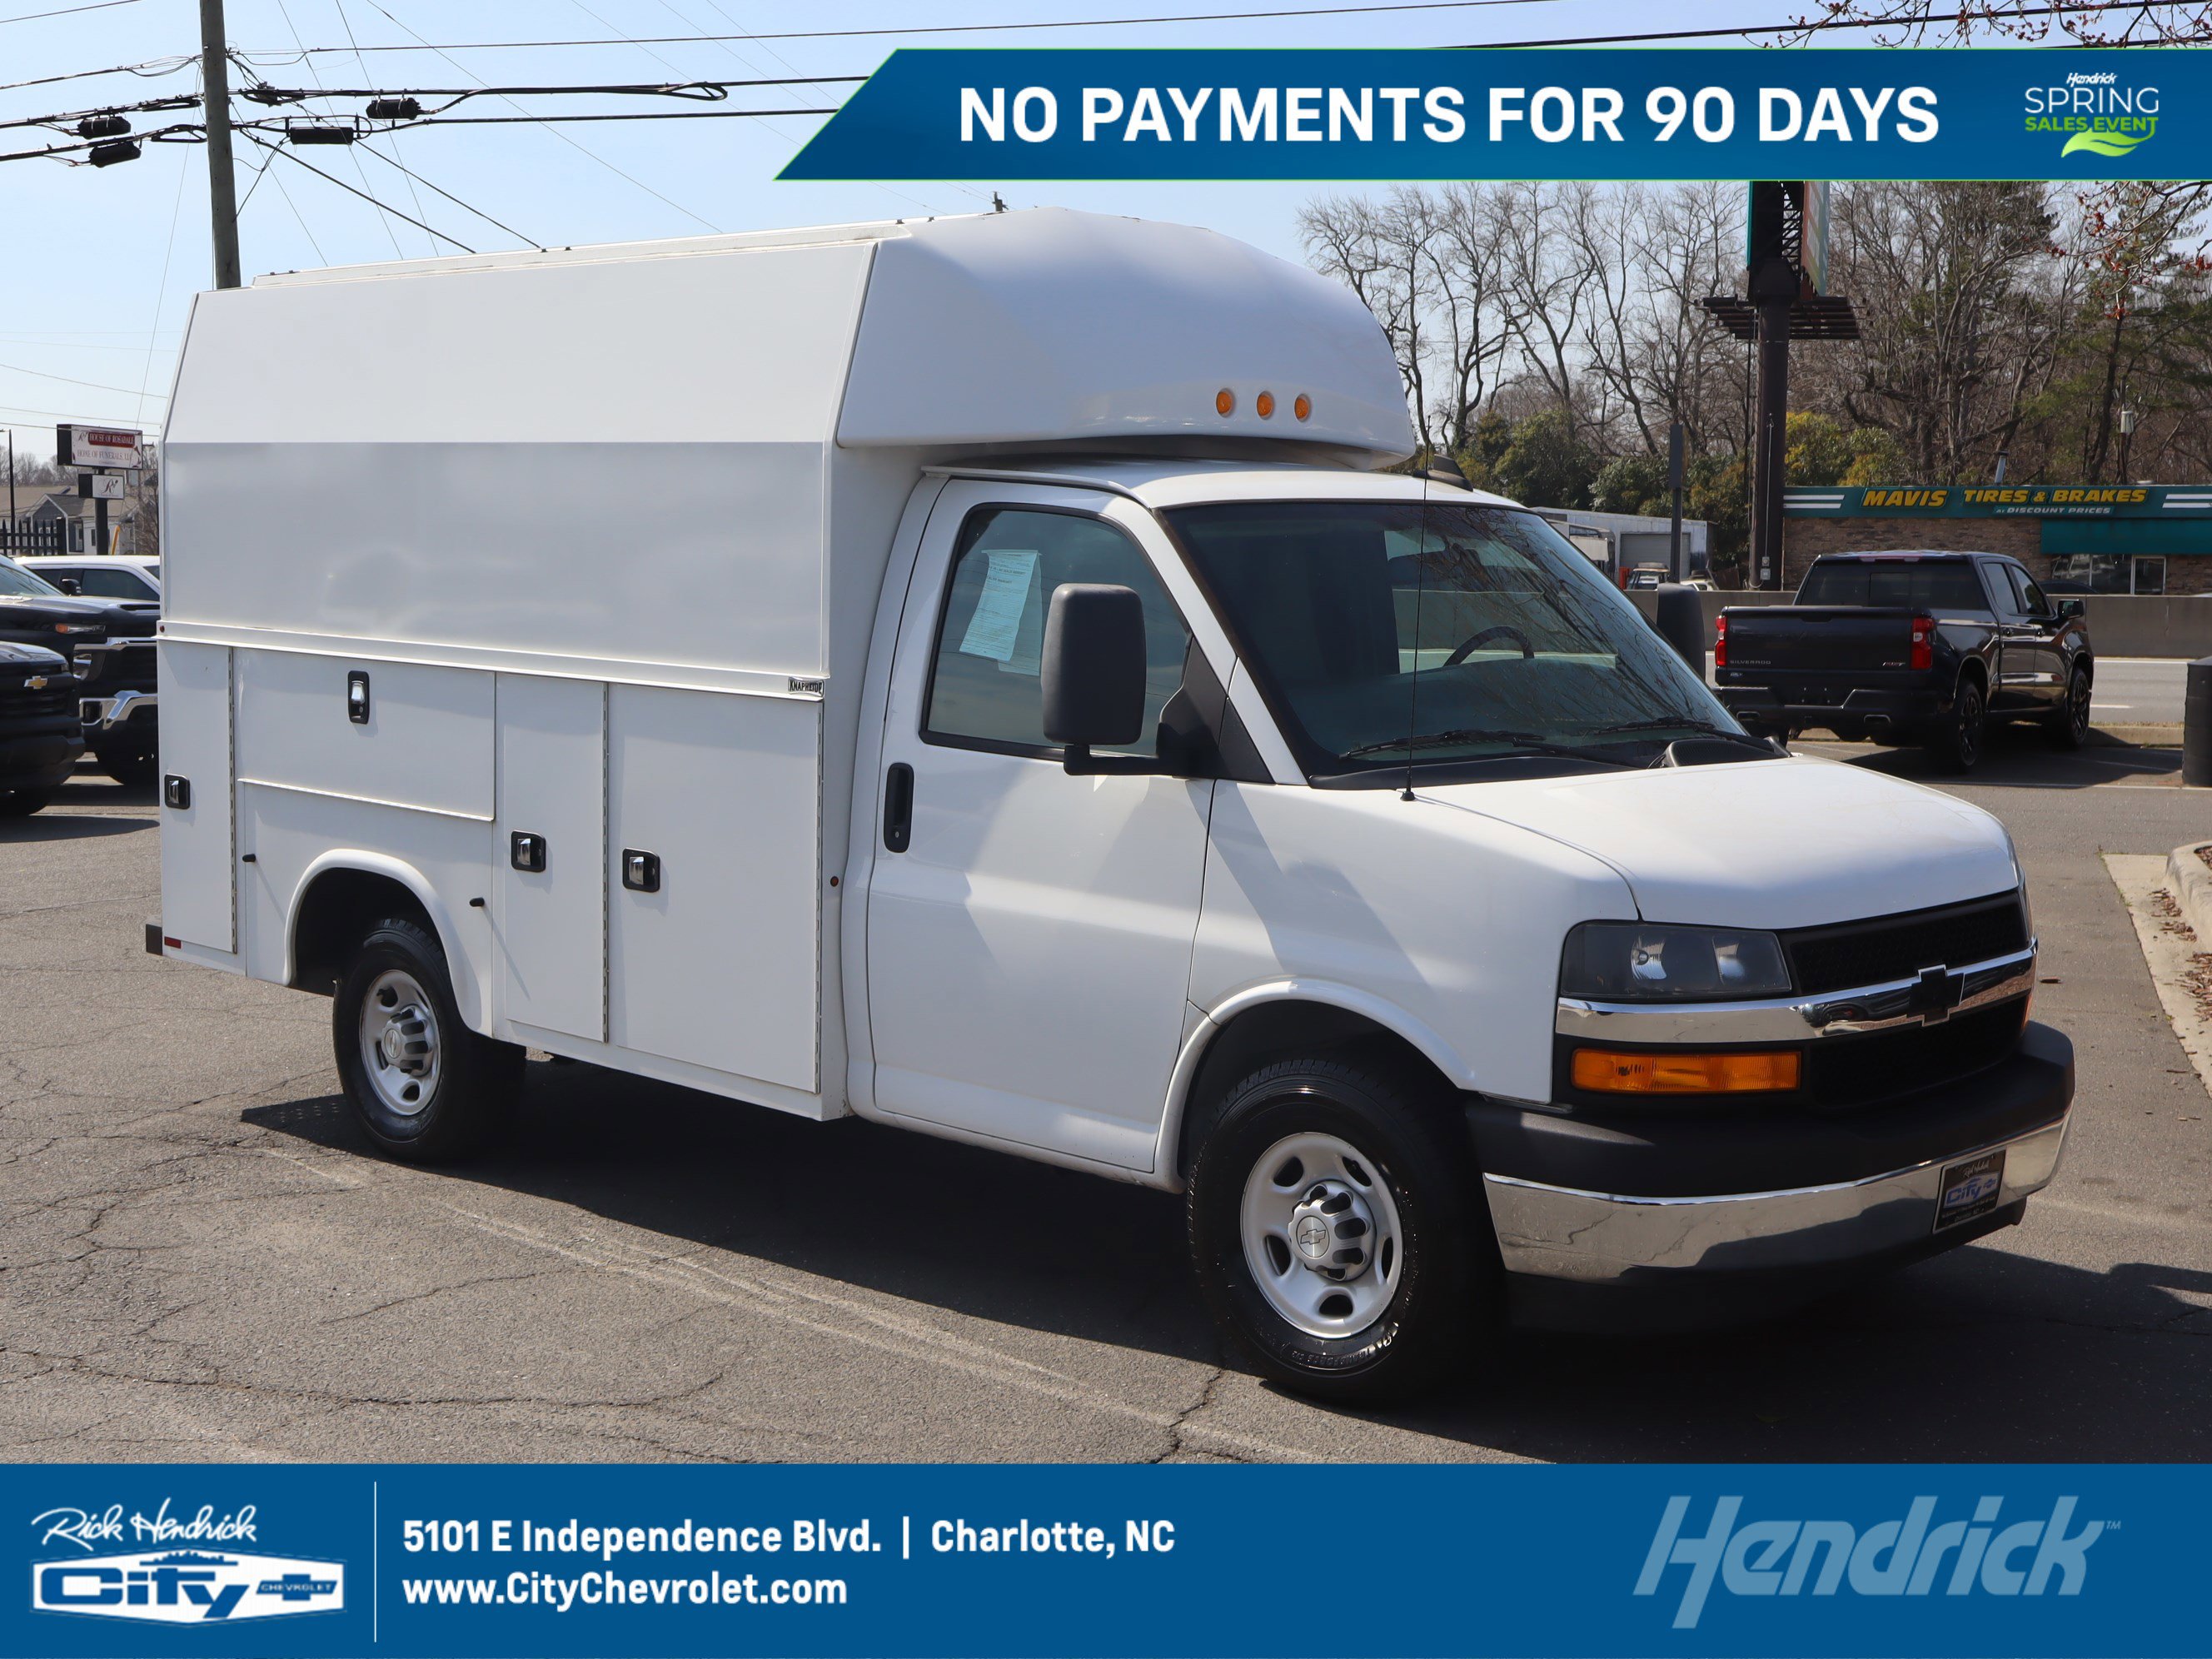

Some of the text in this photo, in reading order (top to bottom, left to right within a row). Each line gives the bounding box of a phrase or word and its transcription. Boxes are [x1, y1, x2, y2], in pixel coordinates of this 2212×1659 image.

[1862, 490, 1948, 507] MAVIS
[1964, 490, 2148, 503] TIRES & BRAKES
